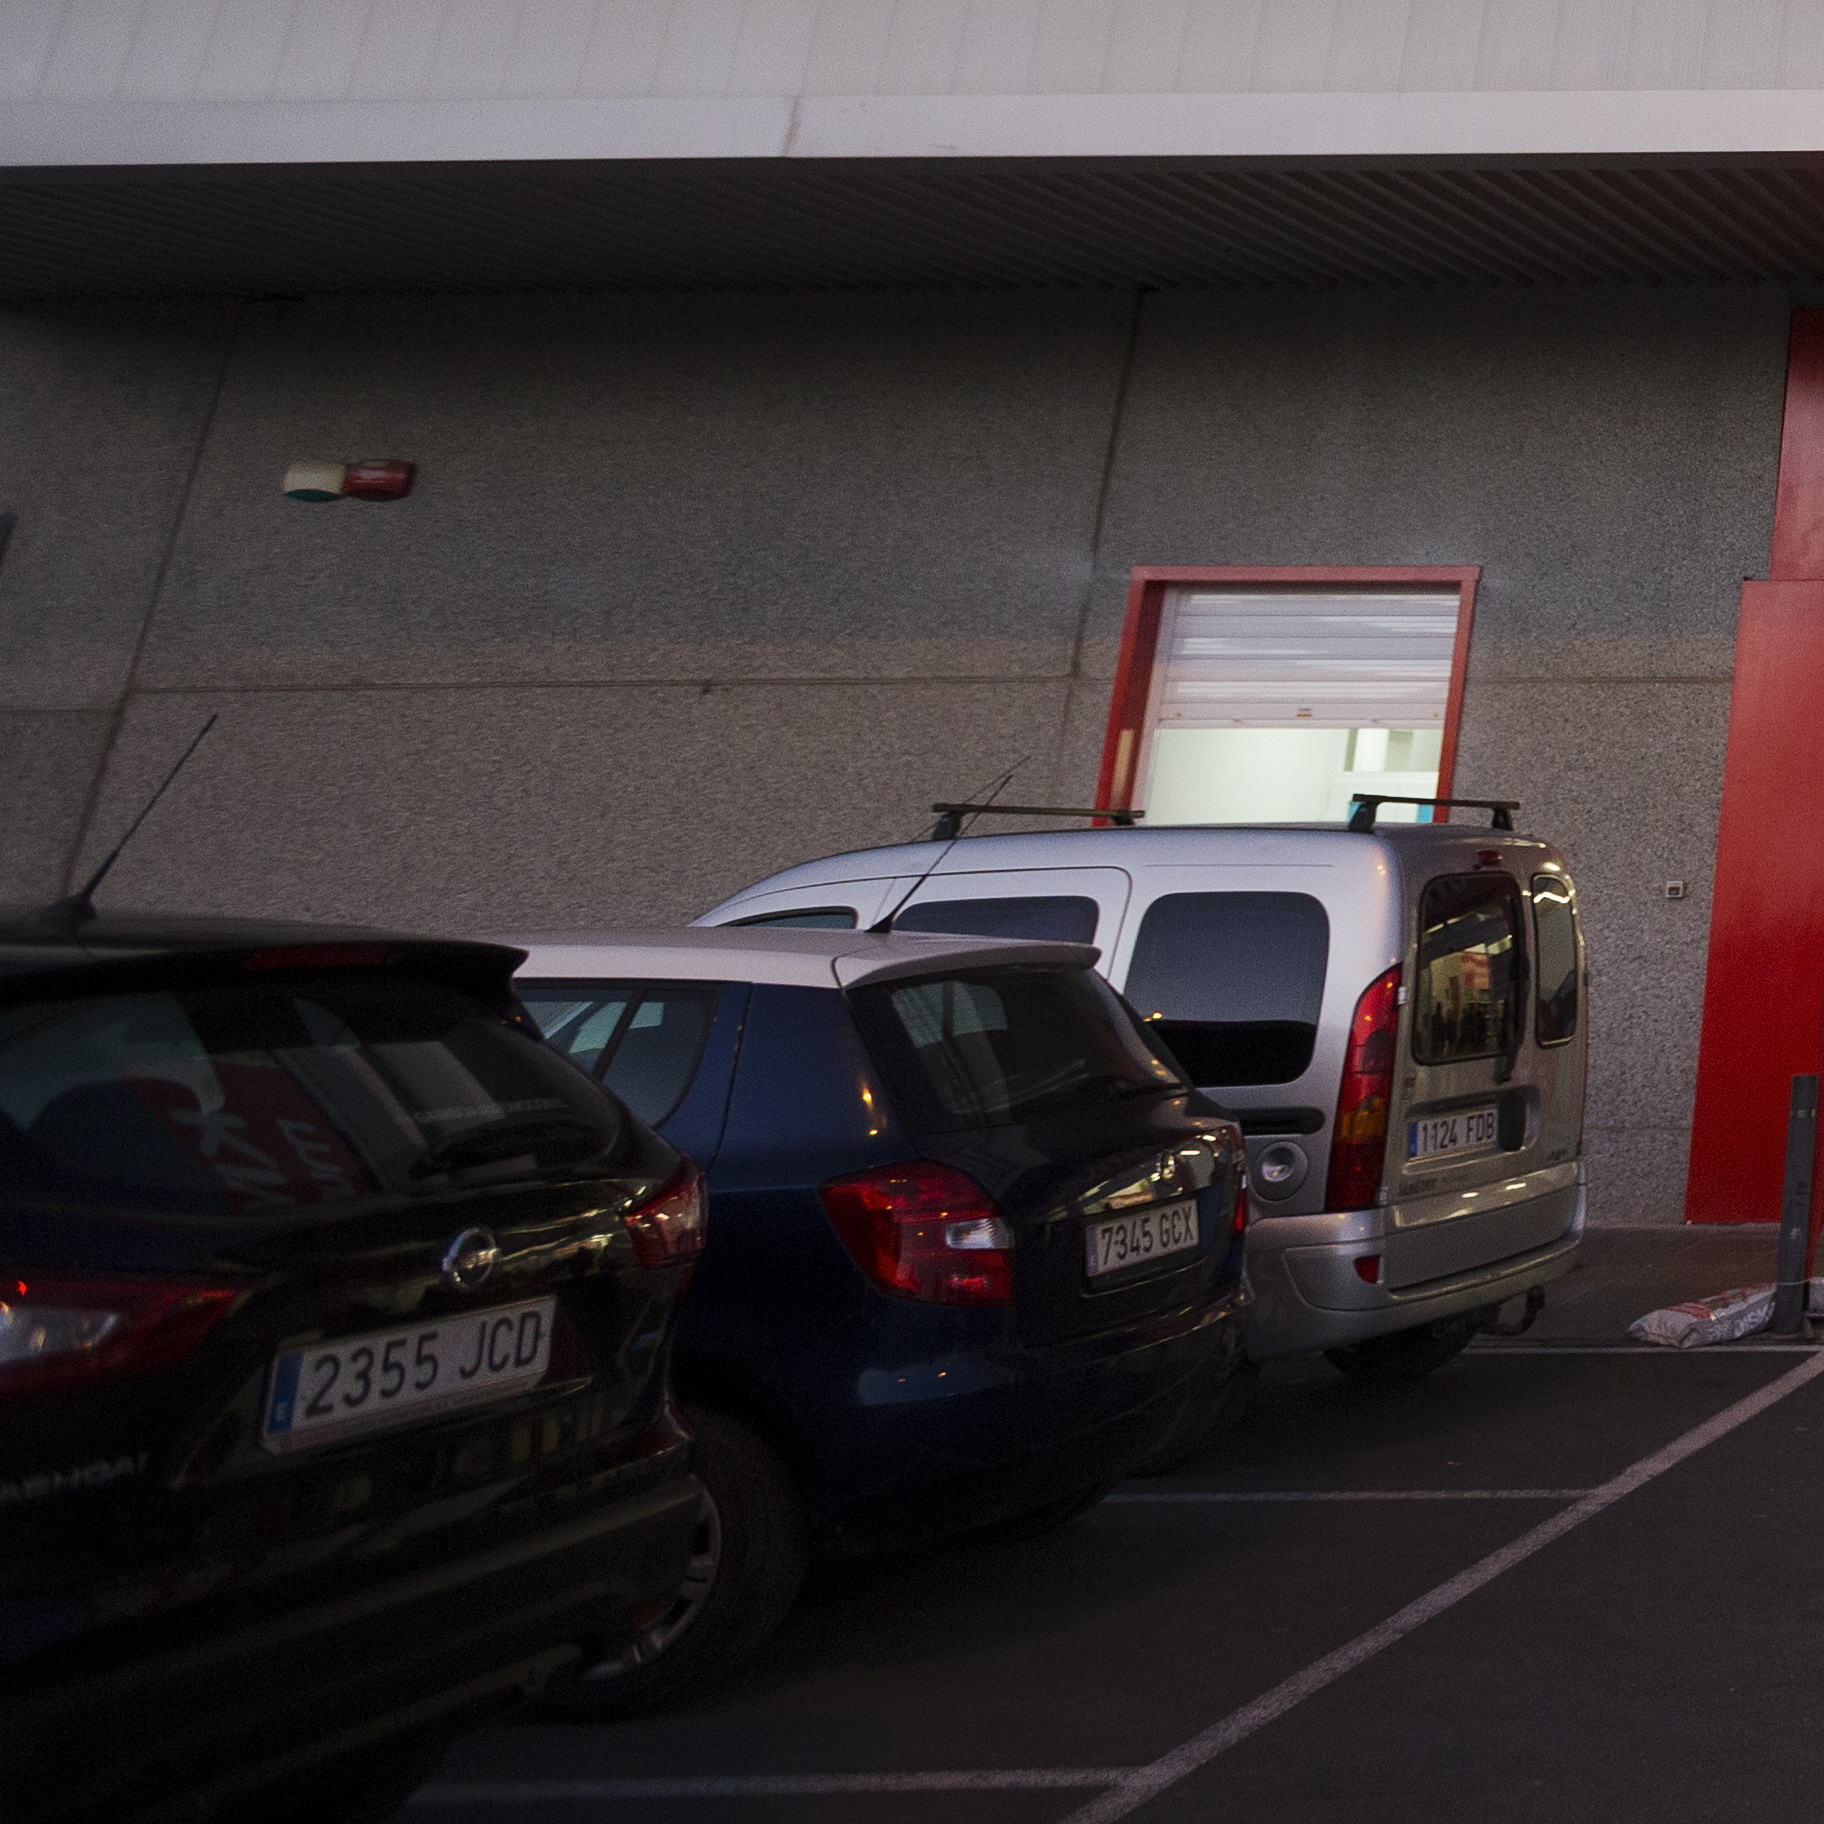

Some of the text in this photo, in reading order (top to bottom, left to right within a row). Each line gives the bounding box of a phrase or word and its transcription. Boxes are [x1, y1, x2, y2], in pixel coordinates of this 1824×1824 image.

[1102, 1205, 1195, 1266] 7345 GCX
[306, 1310, 542, 1419] 2355 JCD
